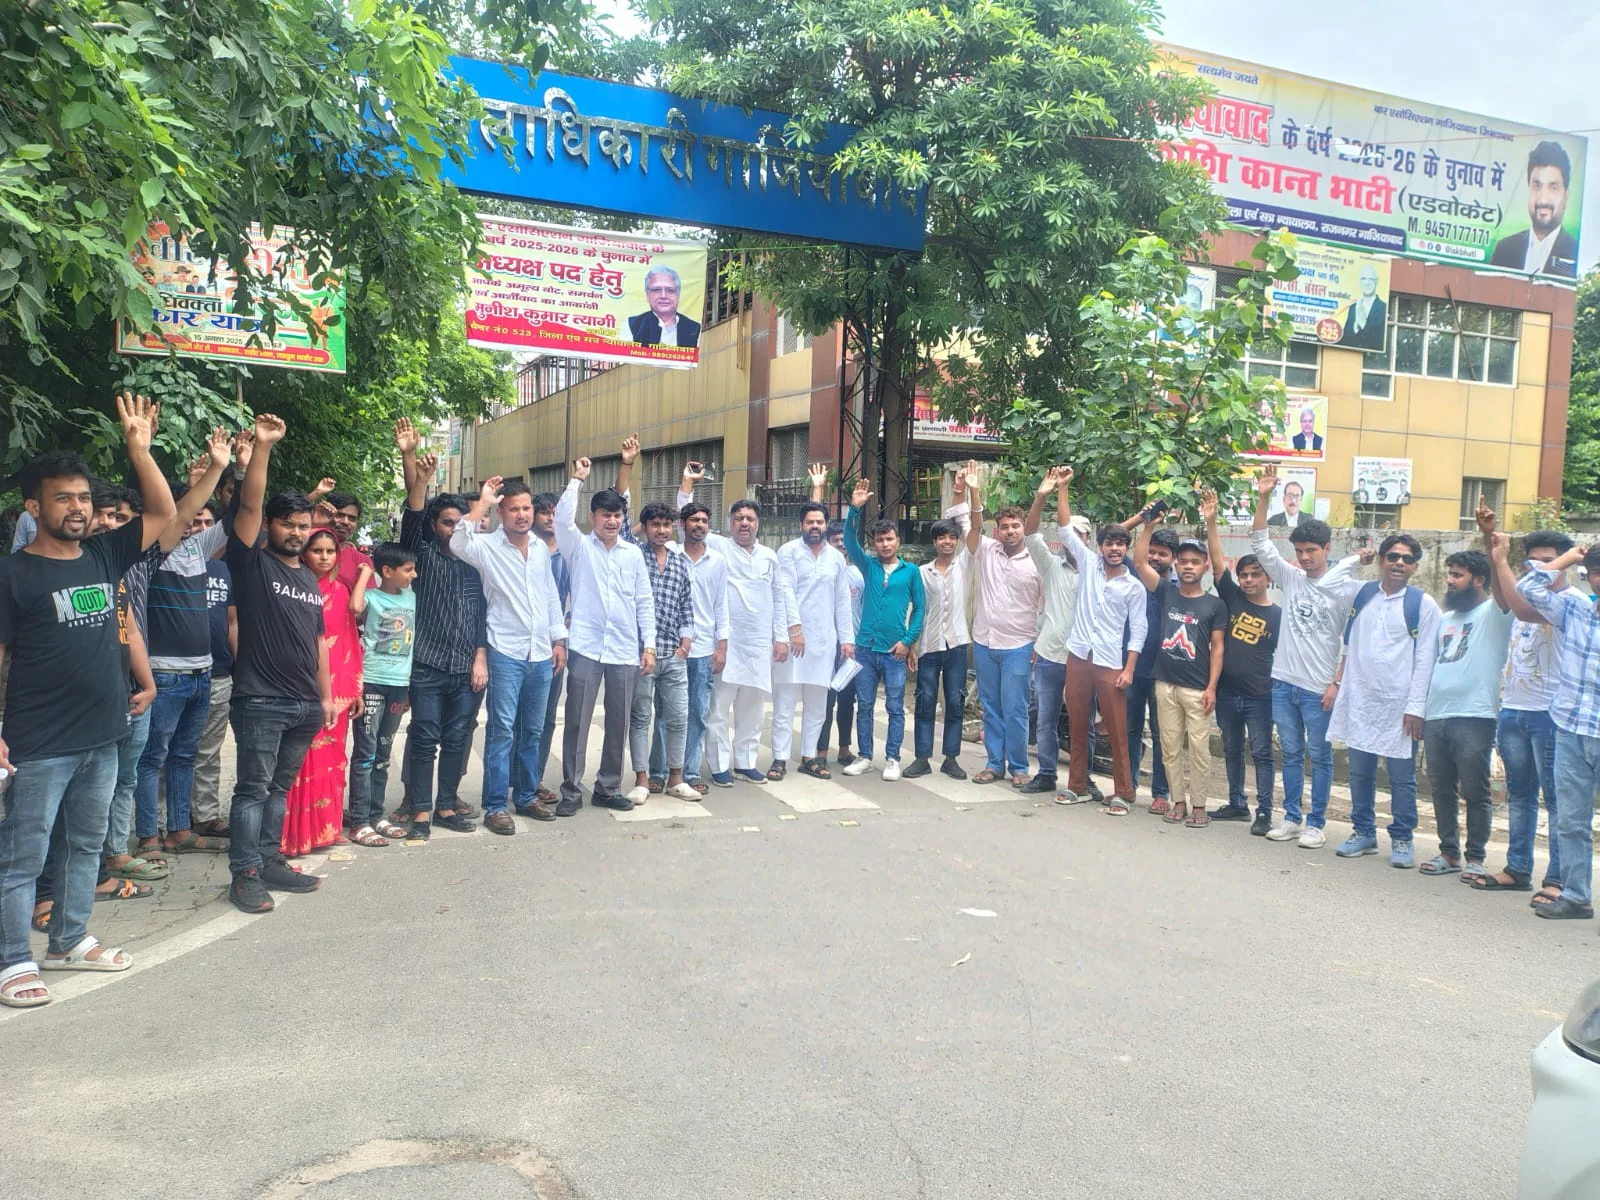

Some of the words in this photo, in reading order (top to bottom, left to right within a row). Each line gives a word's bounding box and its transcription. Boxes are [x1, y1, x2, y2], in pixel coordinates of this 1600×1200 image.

[470, 87, 698, 181] लाधिकारी
[1281, 119, 1301, 150] के
[1306, 125, 1332, 157] वर्ष
[1423, 148, 1441, 178] के
[1445, 159, 1487, 191] चुनाव
[1491, 161, 1507, 191] में
[1238, 156, 1322, 200] कान्त
[1330, 175, 1397, 214] भाटी
[1398, 186, 1503, 229] (एडवोकेट)
[497, 223, 573, 241] एसोसिएशन
[651, 243, 665, 254] के
[1358, 228, 1404, 246] गाजियाबाद
[1408, 216, 1421, 234] M.
[1425, 219, 1490, 246] 9457177171
[511, 238, 579, 256] 2025-2026
[583, 247, 597, 258] के
[601, 251, 636, 264] चुनाव
[639, 254, 653, 265] में
[505, 282, 539, 292] अमूल्य
[549, 263, 583, 282] पद
[588, 262, 625, 297] हेतु
[475, 301, 518, 320] मुनीश
[523, 308, 570, 325] कुमार
[573, 314, 616, 329] त्यागी
[226, 337, 243, 345] 2025
[1320, 327, 1340, 342] 525
[272, 581, 325, 606] BALMAIN
